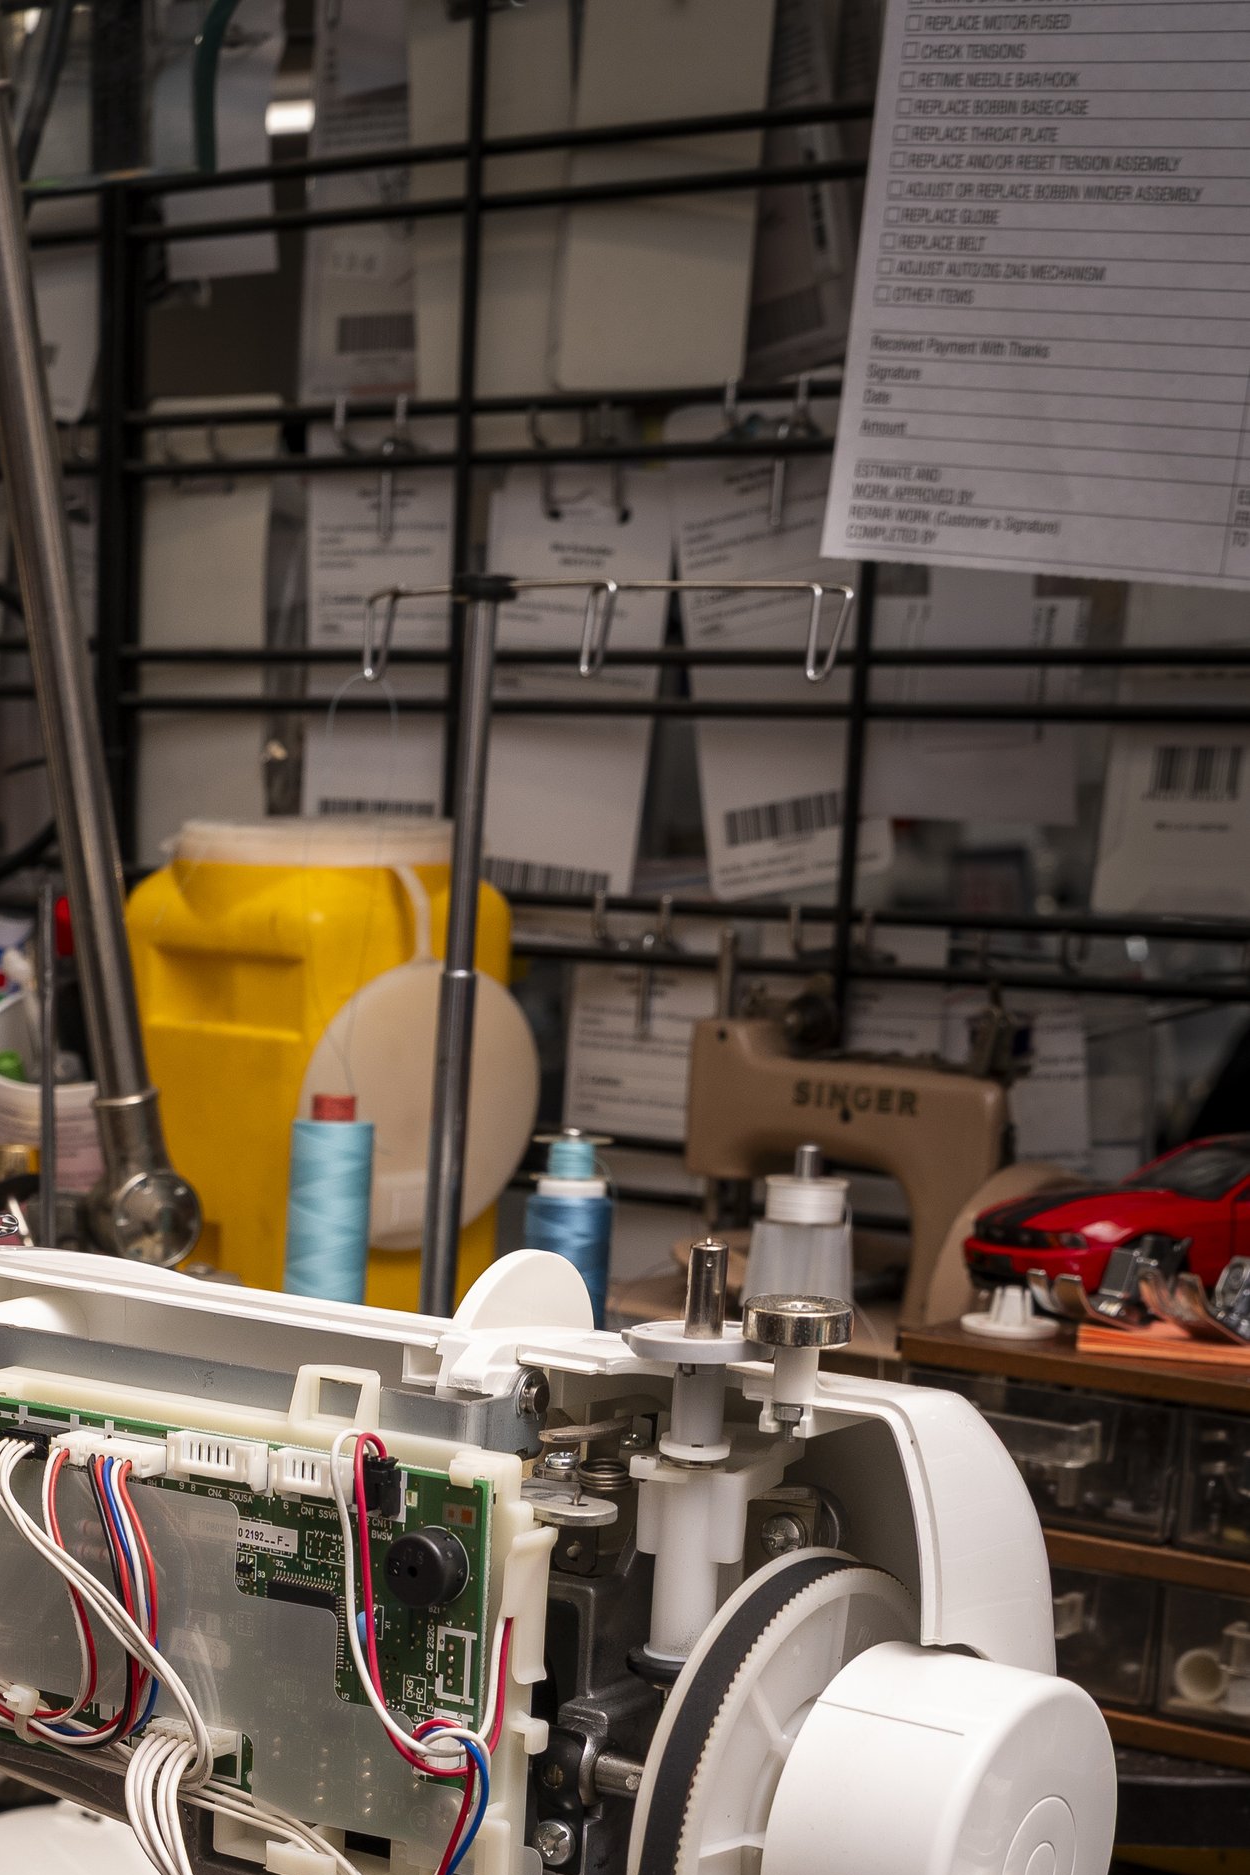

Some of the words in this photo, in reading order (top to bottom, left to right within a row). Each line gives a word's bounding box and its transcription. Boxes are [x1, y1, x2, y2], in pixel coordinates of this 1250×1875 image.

[924, 15, 980, 31] REPLACE
[920, 42, 964, 59] CHECK
[966, 44, 1027, 60] TENSIONS
[916, 72, 963, 87] RETIME
[965, 72, 1014, 87] NEEDLE
[913, 100, 970, 115] REPLACE
[972, 100, 1018, 115] BOBBIN
[910, 127, 969, 142] REPLACE
[971, 127, 1018, 142] THROAT
[1020, 127, 1060, 142] PLATE
[908, 153, 965, 169] REPLACE
[1016, 154, 1055, 170] RESET
[1059, 155, 1111, 171] TENSION
[1113, 155, 1182, 172] ASSEMBLY
[905, 181, 954, 198] ADJUST
[955, 182, 975, 198] OR
[977, 182, 1033, 199] REPLACE
[1035, 184, 1080, 201] BOBBIN
[1082, 185, 1132, 201] WINDER
[1134, 186, 1204, 203] ASSEMBLY
[900, 208, 957, 223] REPLACE
[959, 208, 1000, 224] GLOBE
[898, 234, 955, 251] REPLACE
[956, 235, 988, 252] BELT
[895, 260, 945, 278] ADJUST
[1030, 263, 1107, 281] MECHANISM
[893, 286, 934, 303] OTHER
[936, 287, 975, 305] ITEMS
[870, 334, 926, 353] Received
[926, 337, 977, 357] Payment
[979, 340, 1007, 356] With
[1009, 341, 1051, 359] Thanks
[866, 362, 922, 381] Signature
[863, 388, 892, 405] Date
[859, 419, 908, 436] Amount
[853, 462, 911, 480] ESTIMATE
[913, 466, 942, 482] AND
[893, 485, 954, 504] APPROVED
[956, 489, 976, 505] BY
[895, 507, 930, 523] WORK
[845, 525, 918, 544] COMPLETED
[922, 529, 939, 545] BY
[792, 1080, 918, 1116] SINGER
[179, 1482, 185, 1490] 9
[190, 1483, 197, 1492] 8
[207, 1488, 223, 1498] CN4
[228, 1491, 253, 1504] SOUSA
[283, 1501, 289, 1510] 6
[318, 1509, 339, 1520] SSVR
[371, 1530, 393, 1541] BWSW
[426, 1624, 435, 1649] 232C
[426, 1652, 434, 1671] CN2
[405, 1680, 414, 1698] CN3
[416, 1687, 424, 1700] FC
[426, 1704, 434, 1712] 3
